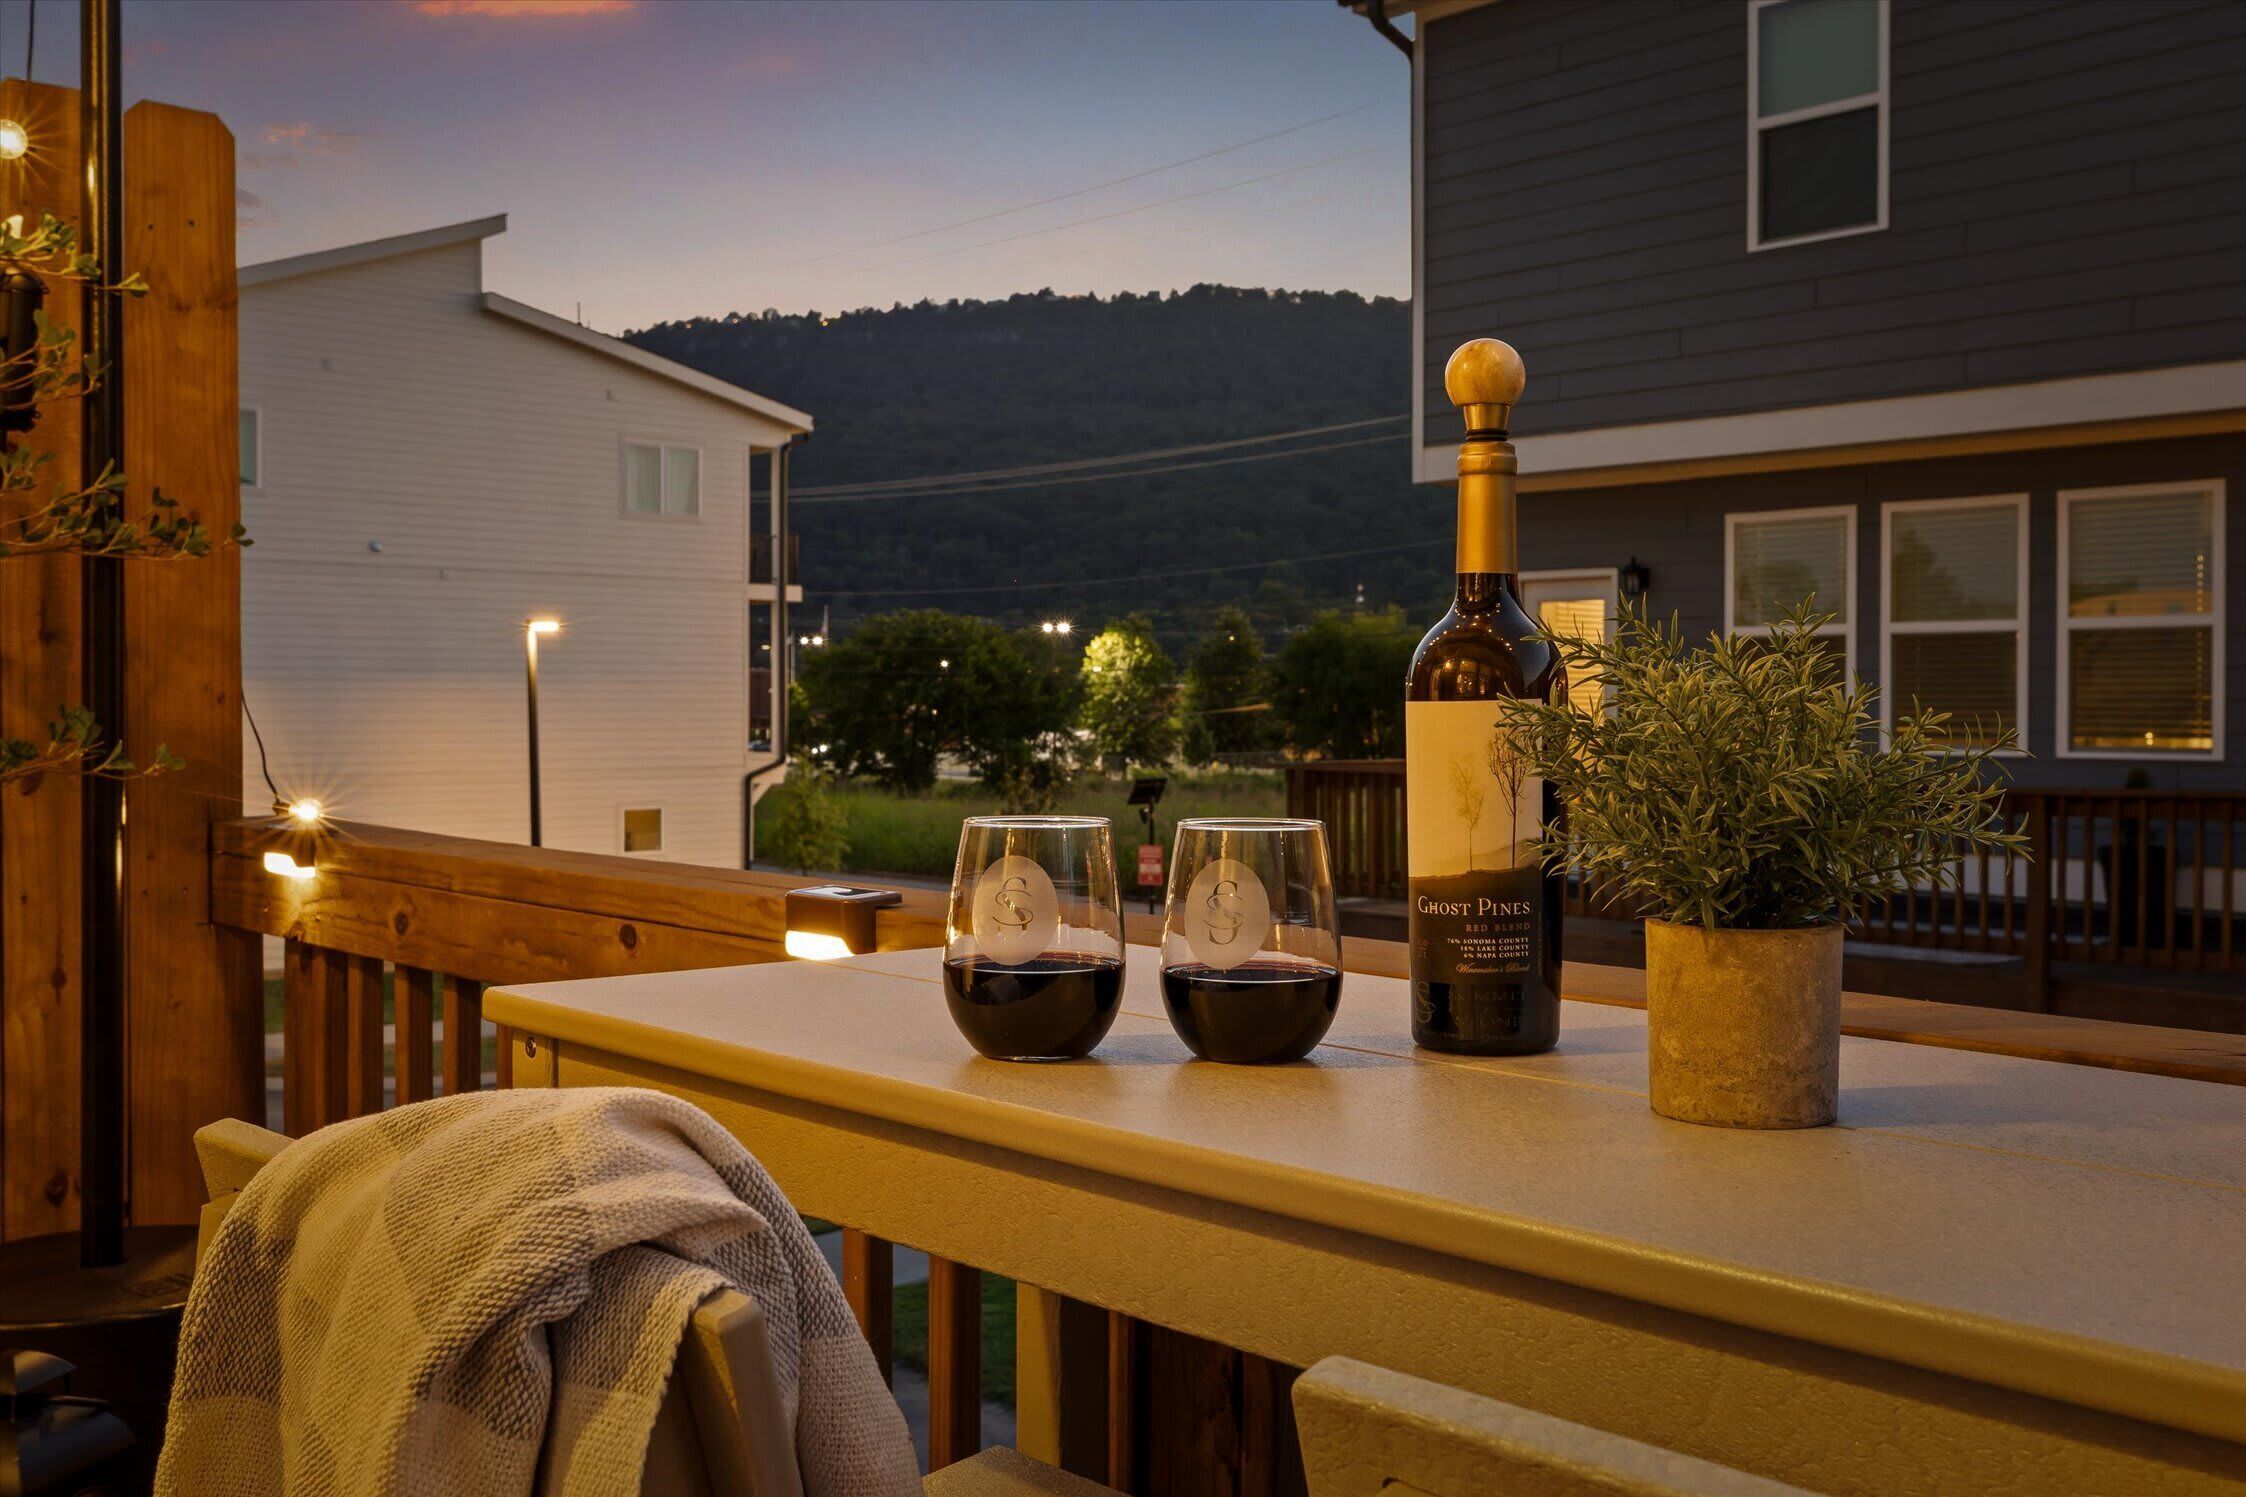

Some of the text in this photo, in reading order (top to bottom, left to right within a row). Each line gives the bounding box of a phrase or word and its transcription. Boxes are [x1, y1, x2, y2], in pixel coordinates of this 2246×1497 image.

[1466, 922, 1531, 932] RED BLEND
[1463, 937, 1496, 945] SONOMA
[1498, 936, 1530, 944] COUNTY
[1498, 944, 1530, 952] COUNTY
[1498, 951, 1530, 959] COUNTY
